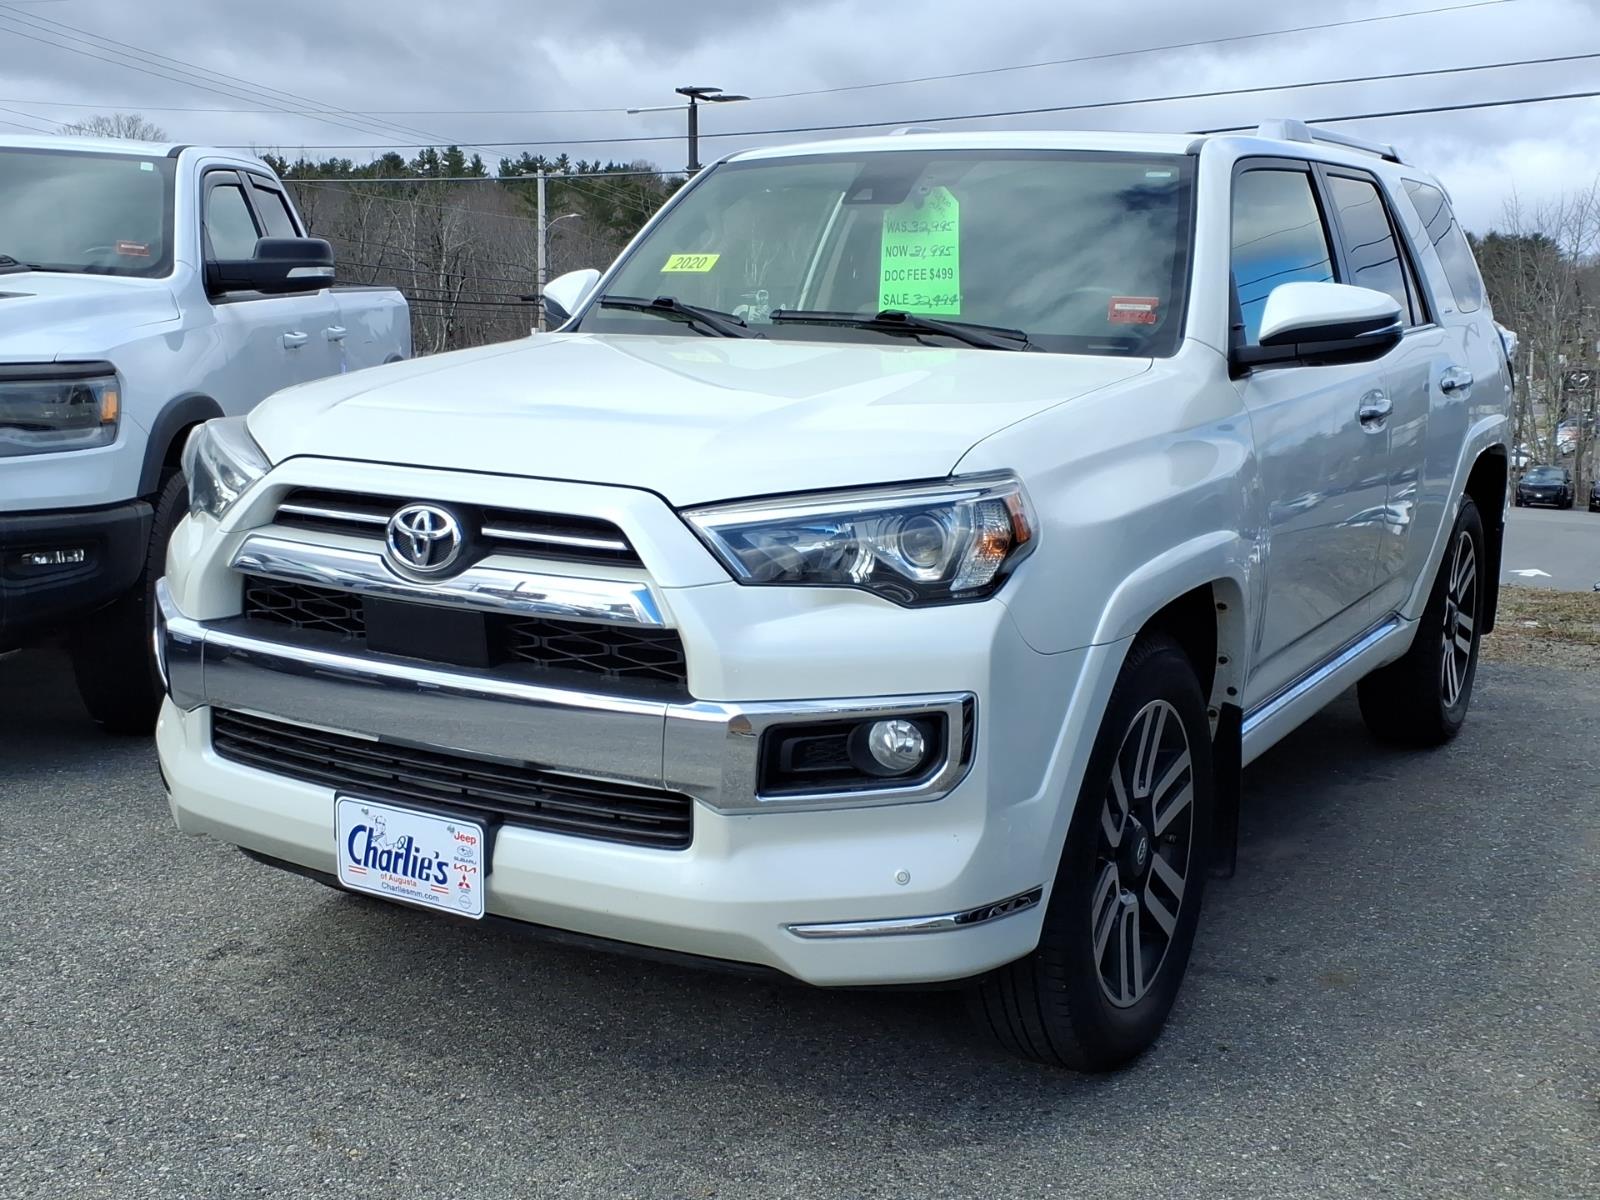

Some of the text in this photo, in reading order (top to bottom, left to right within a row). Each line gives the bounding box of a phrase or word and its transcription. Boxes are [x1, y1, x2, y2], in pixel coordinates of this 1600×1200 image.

[887, 221, 907, 233] WAS
[886, 244, 955, 259] NOW 31,995
[671, 256, 708, 269] 2020
[885, 268, 953, 282] DOC FEE $499
[883, 294, 909, 306] SALE
[454, 831, 477, 845] Jeep
[347, 824, 449, 885] Charlie's
[389, 874, 417, 888] Augusta
[381, 881, 440, 903] Charliesmm.com
